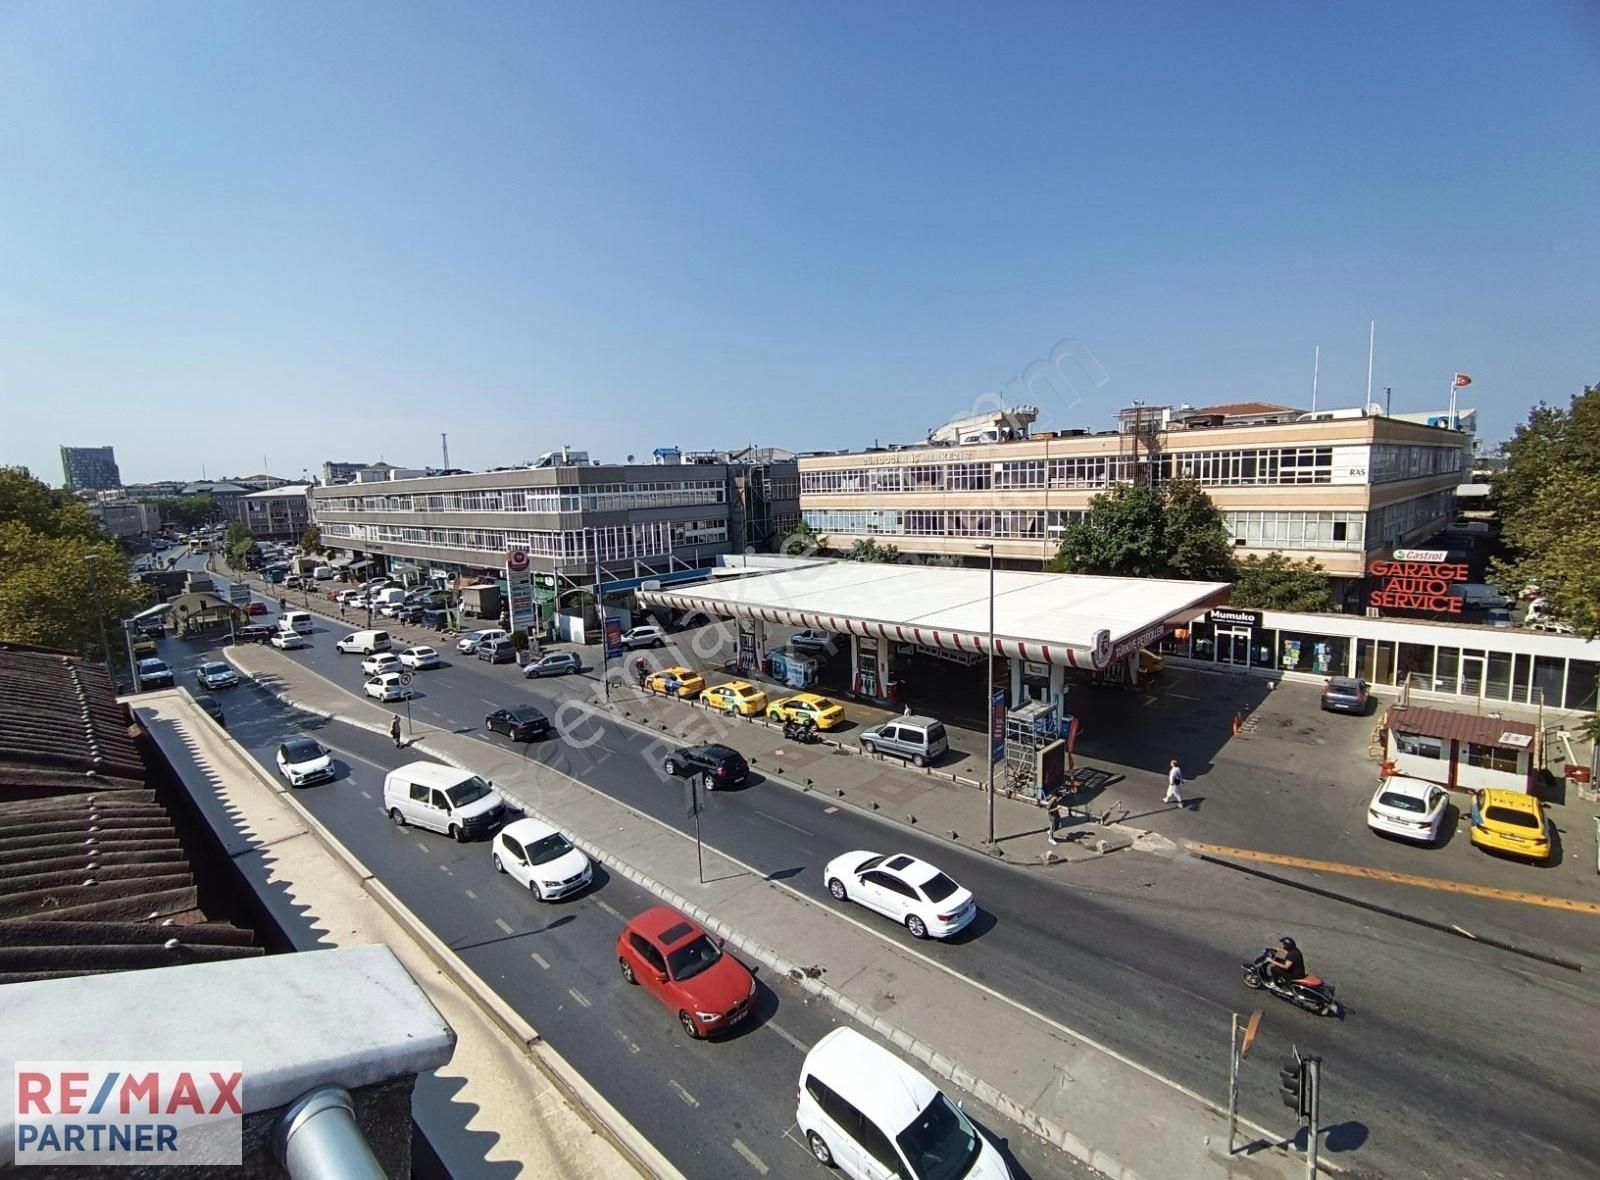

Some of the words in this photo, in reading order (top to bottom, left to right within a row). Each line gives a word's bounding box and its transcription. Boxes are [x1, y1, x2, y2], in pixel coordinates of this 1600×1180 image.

[1349, 468, 1366, 476] RAS
[1406, 551, 1445, 561] Castrol
[1370, 560, 1469, 580] GARAGE
[1385, 577, 1447, 596] AUTO
[1370, 591, 1463, 613] SERVICE
[1211, 610, 1255, 622] Mumuko
